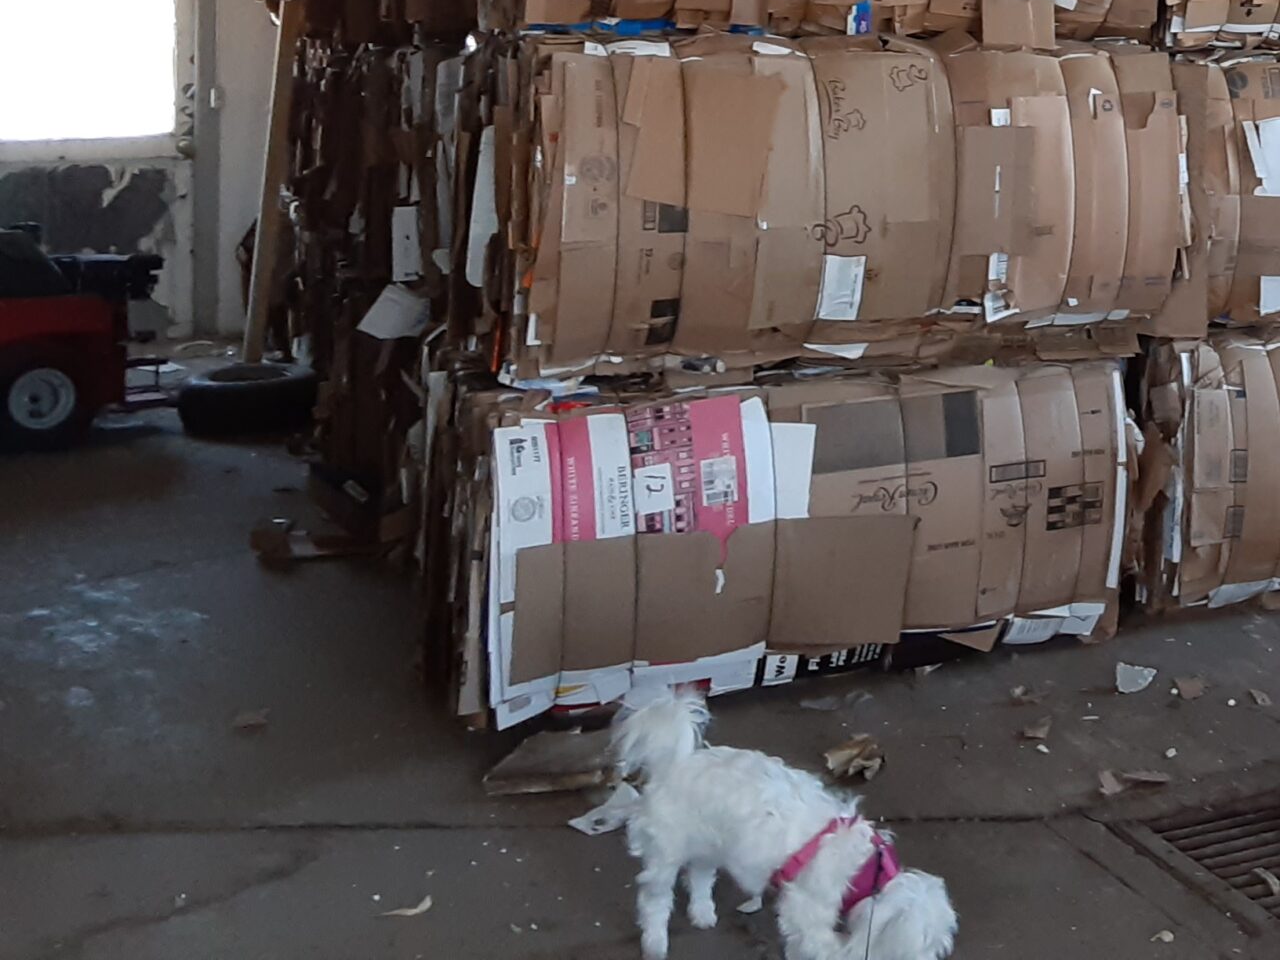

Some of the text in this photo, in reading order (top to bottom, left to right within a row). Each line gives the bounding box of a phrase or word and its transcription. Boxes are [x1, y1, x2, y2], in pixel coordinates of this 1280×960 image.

[566, 456, 577, 490] WHITE
[643, 474, 668, 499] 12
[617, 465, 631, 529] BERINGER
